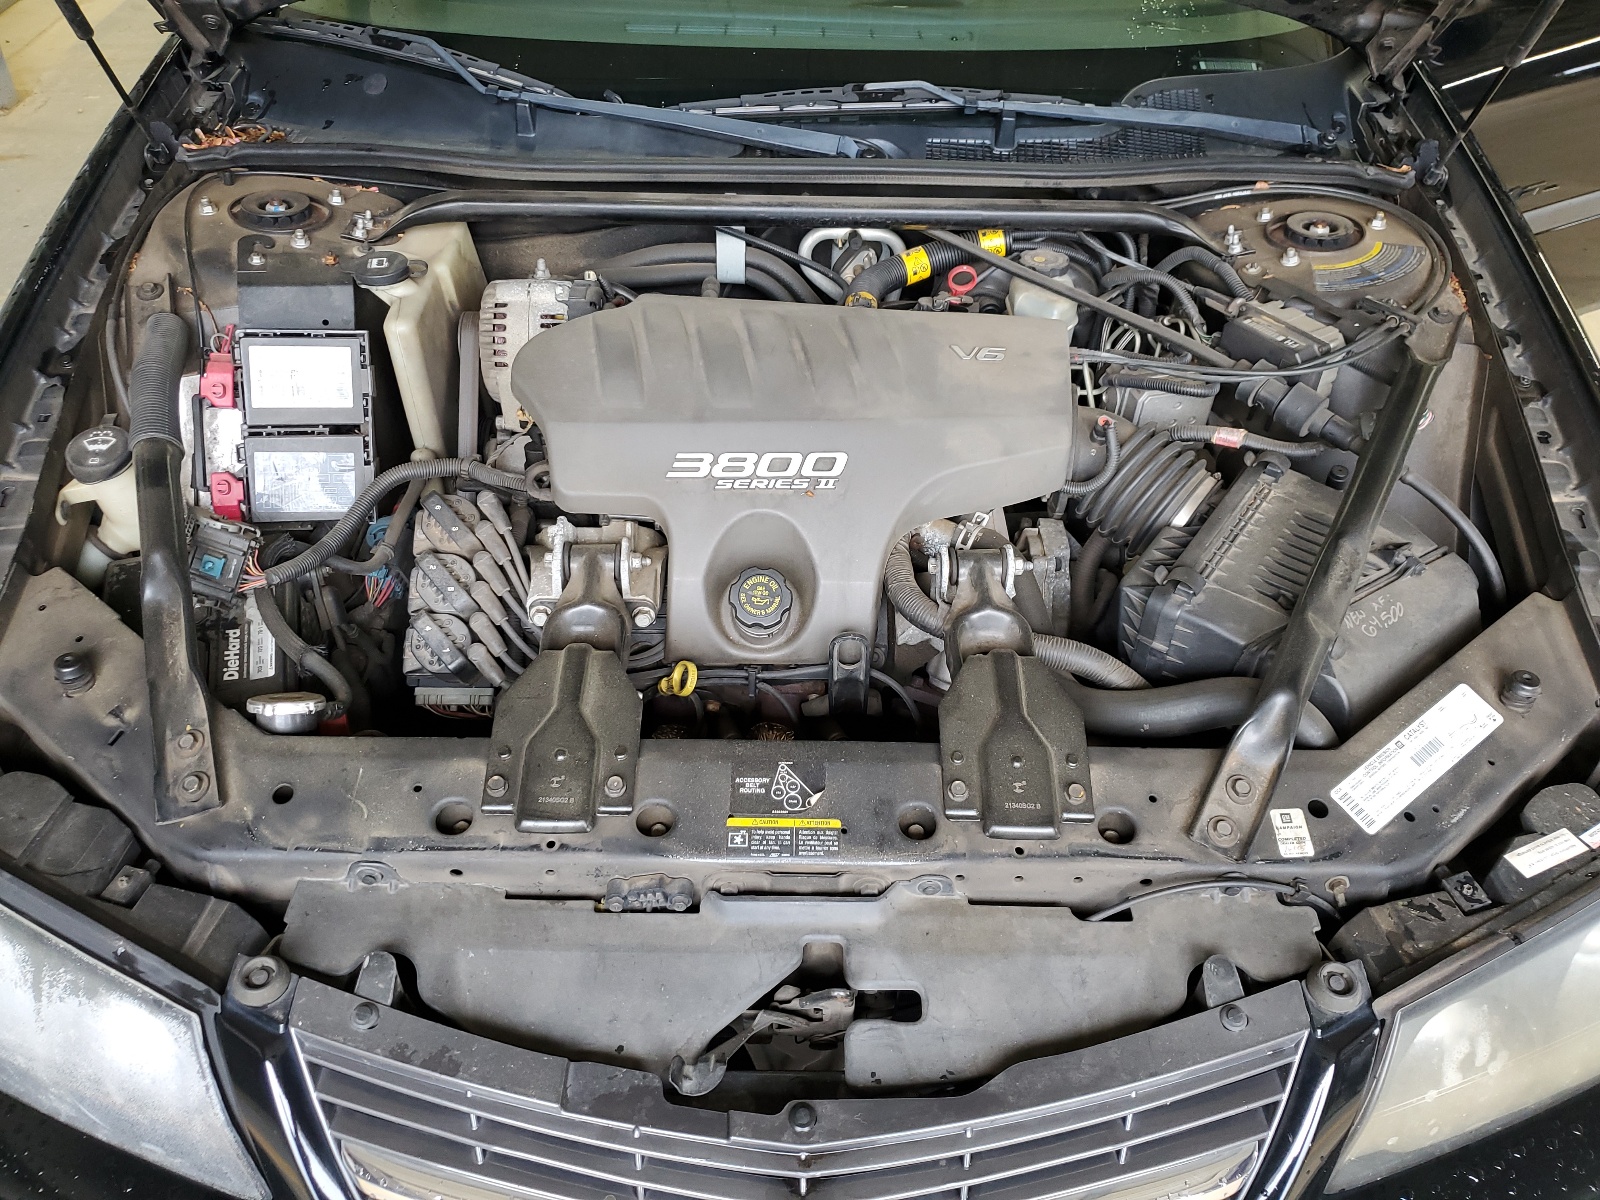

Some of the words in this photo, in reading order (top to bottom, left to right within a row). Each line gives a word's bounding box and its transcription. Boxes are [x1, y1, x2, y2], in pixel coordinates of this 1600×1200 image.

[949, 344, 1007, 361] V6
[665, 451, 849, 478] 3800
[714, 478, 811, 490] SERIES
[814, 478, 839, 490] II
[743, 575, 770, 590] ENGINE
[769, 580, 779, 592] OIL
[1344, 610, 1366, 629] NEW
[223, 627, 240, 681] DieHard
[1403, 719, 1427, 741] CATALYST
